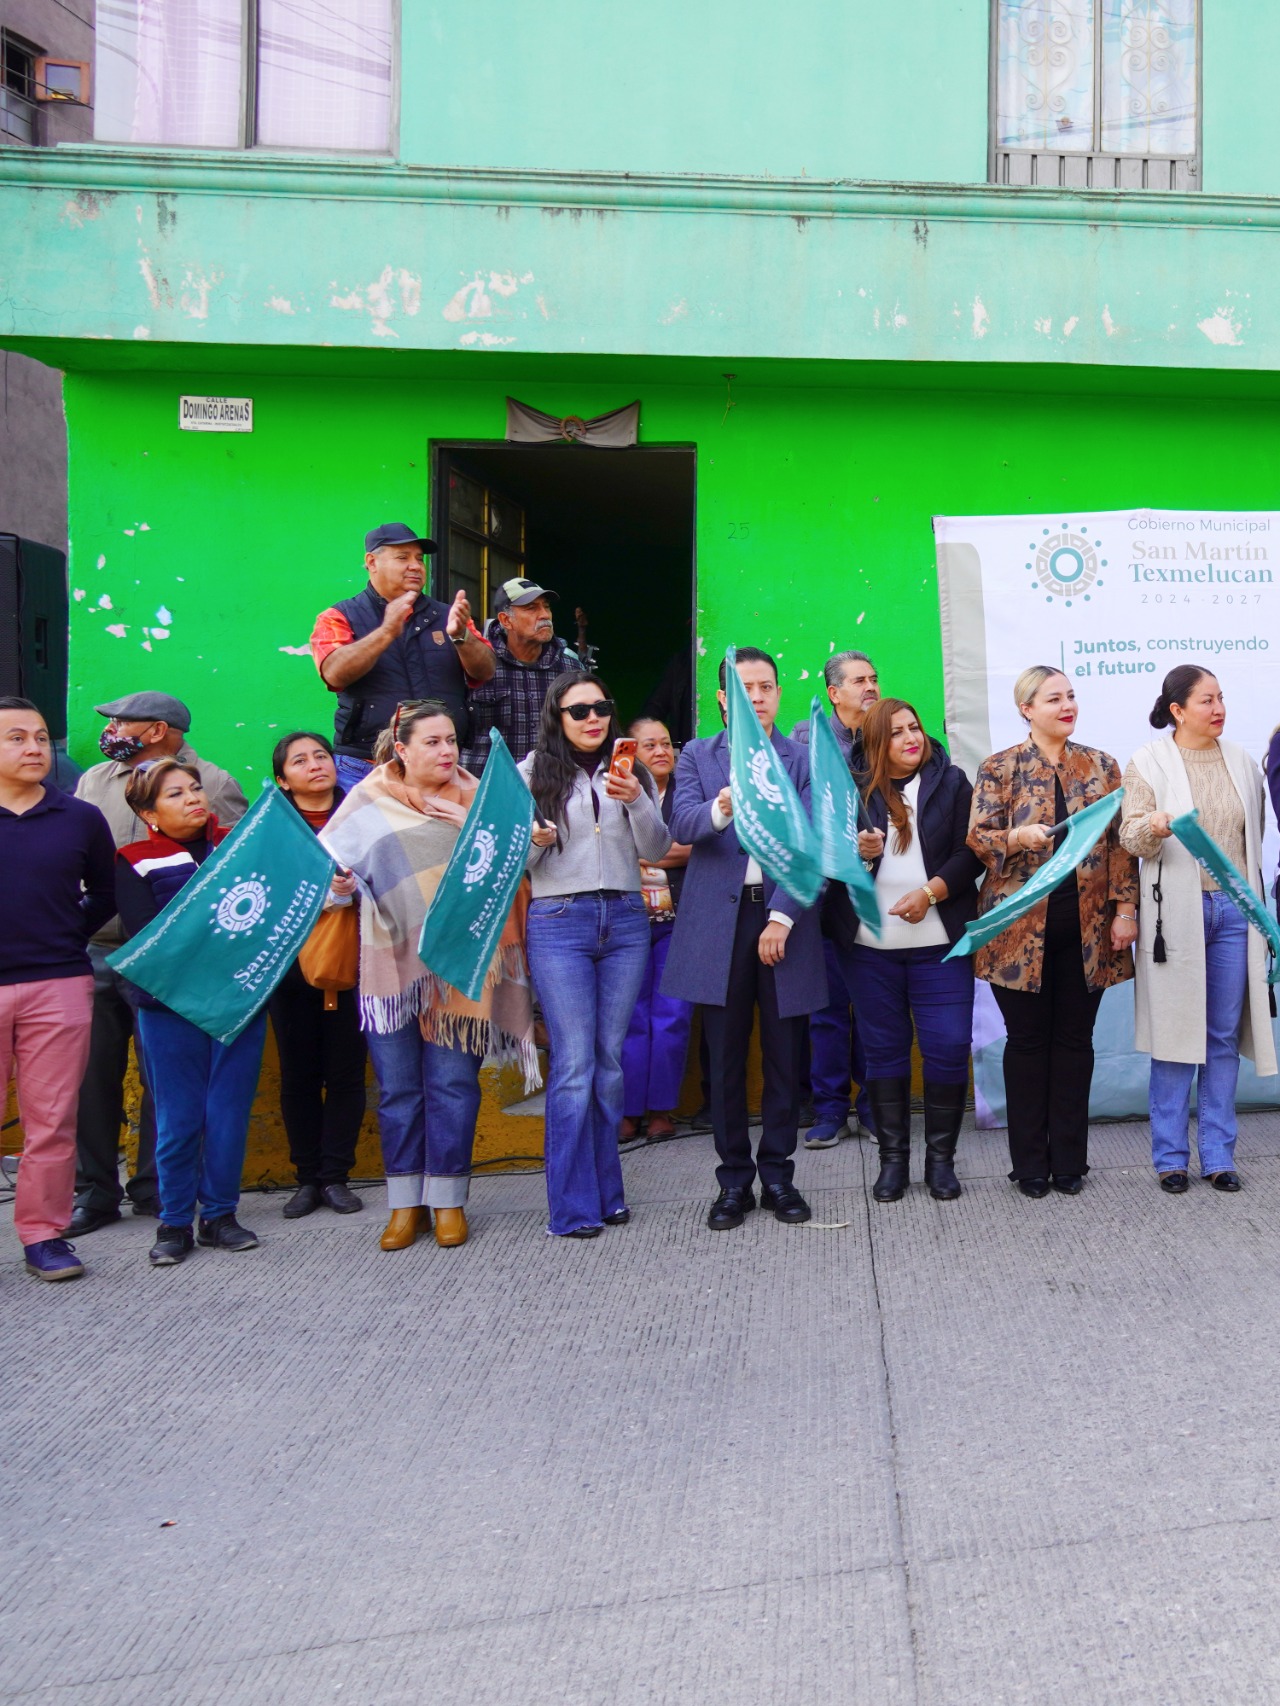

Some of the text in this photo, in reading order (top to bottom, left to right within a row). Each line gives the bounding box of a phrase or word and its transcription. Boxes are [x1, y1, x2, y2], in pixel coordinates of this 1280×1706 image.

[183, 399, 250, 421] DOMINGO ARENAS
[1128, 517, 1270, 534] Gobierno Municipal
[1132, 540, 1269, 561] San Martín
[1128, 563, 1274, 583] Texmelucan
[1073, 636, 1269, 654] Juntos, construyendo
[1075, 657, 1156, 677] el futuro
[468, 896, 493, 933] San
[233, 878, 309, 984] San Martín
[242, 882, 319, 993] Texmelucan
